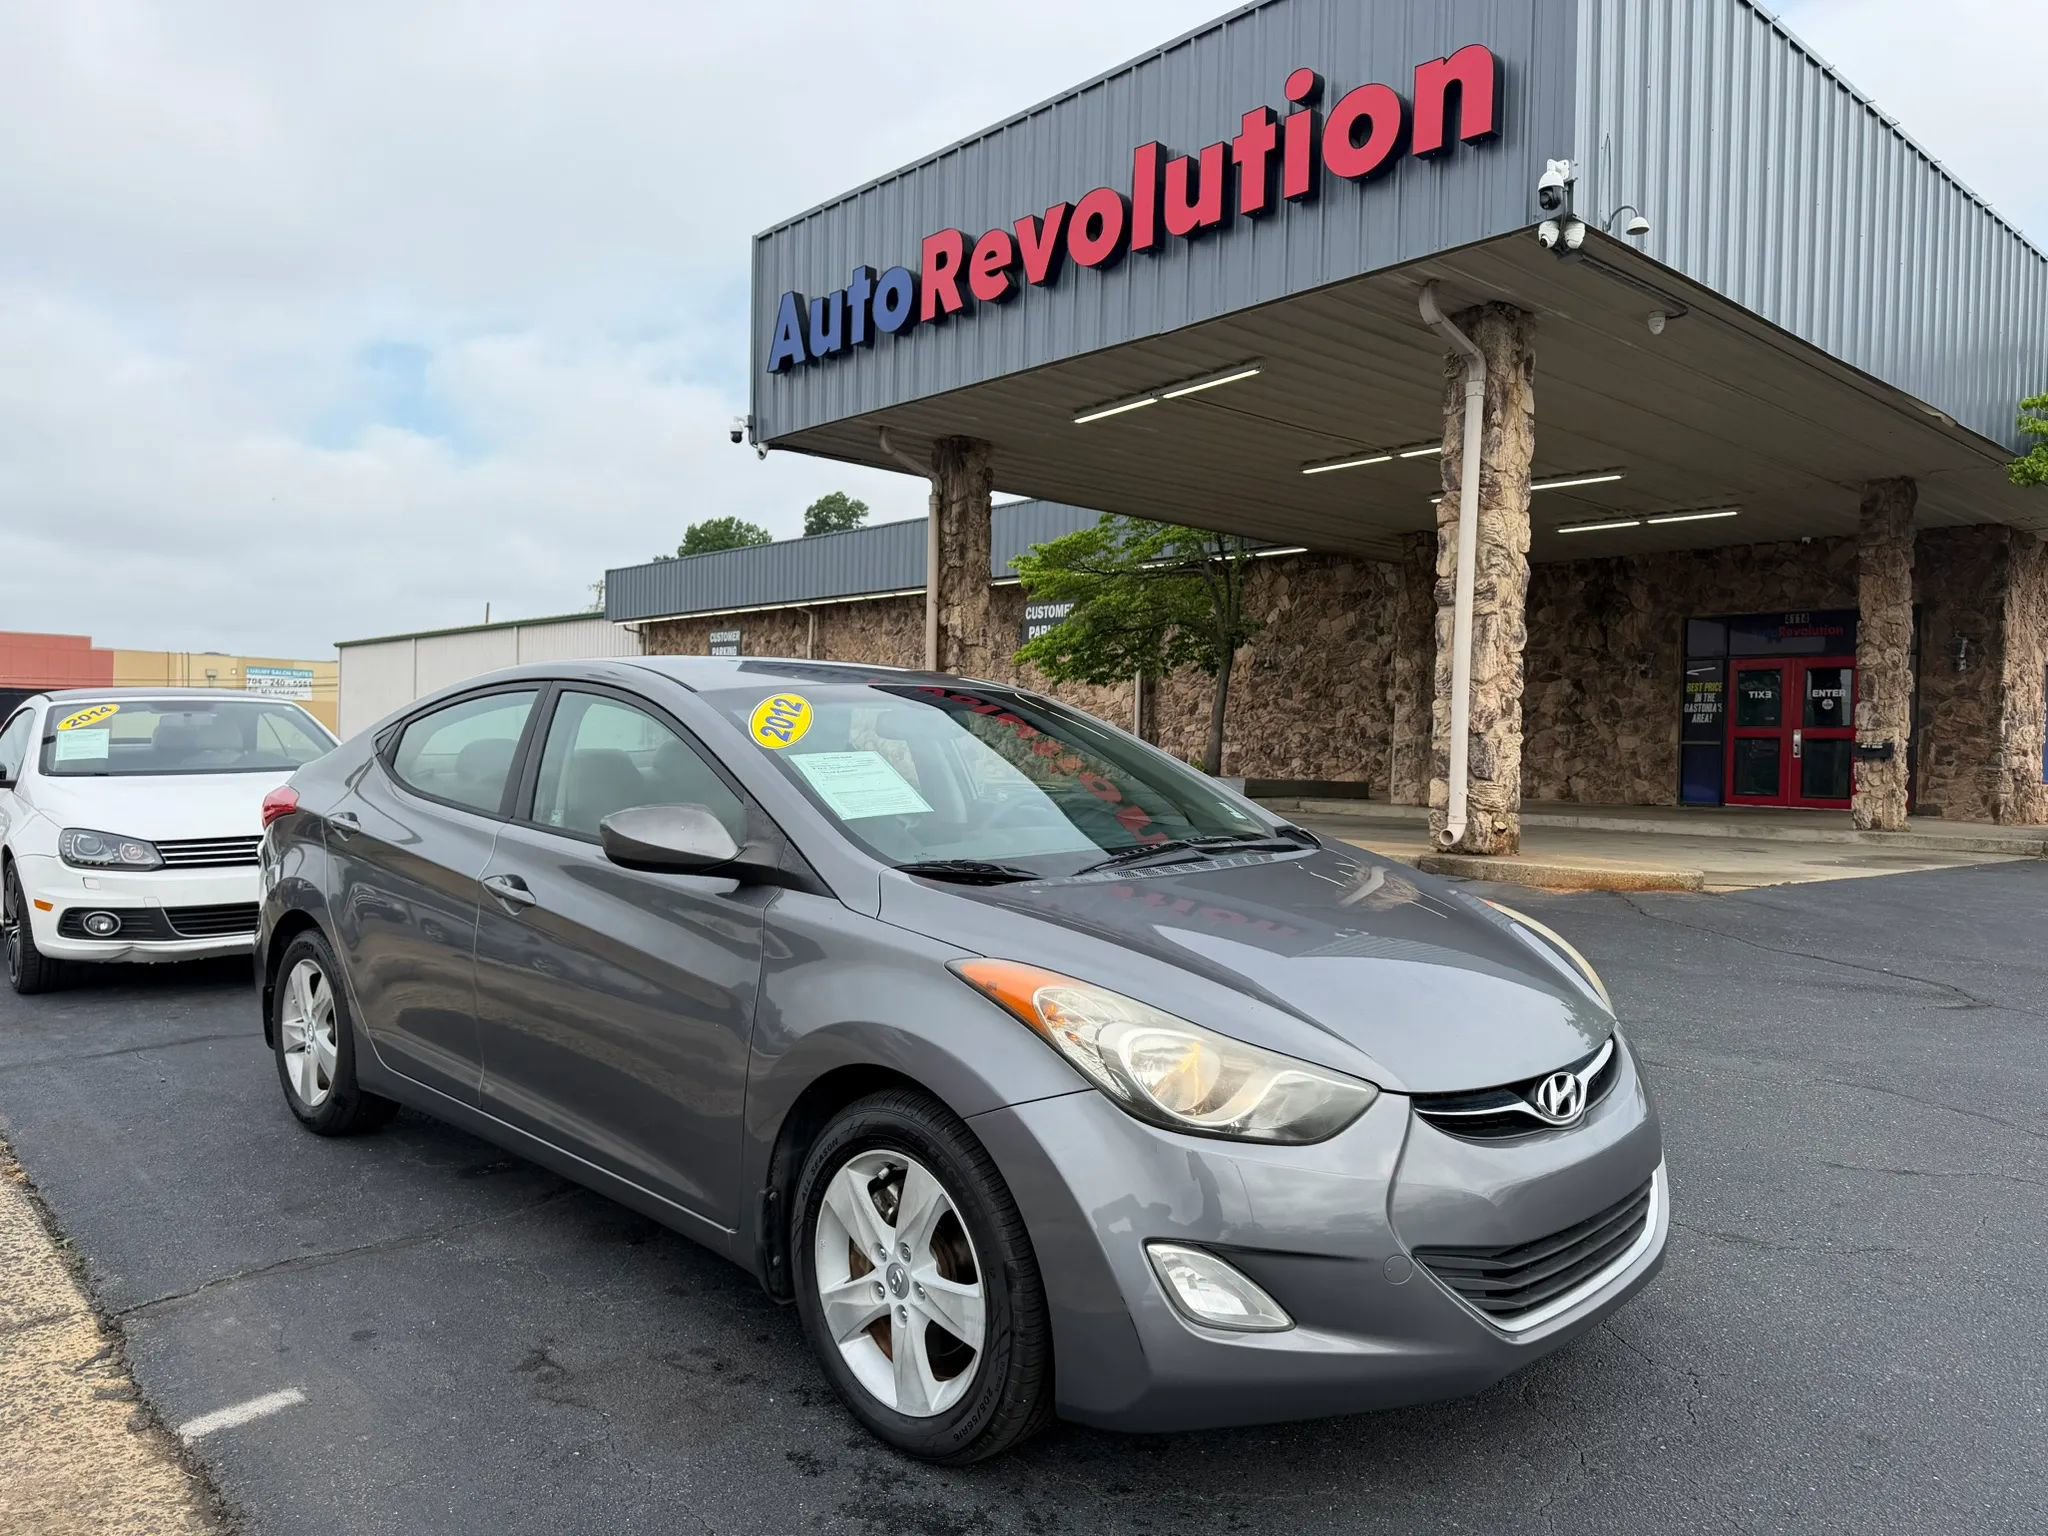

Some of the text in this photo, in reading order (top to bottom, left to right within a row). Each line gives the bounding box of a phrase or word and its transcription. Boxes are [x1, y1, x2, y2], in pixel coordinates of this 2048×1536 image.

[1025, 603, 1074, 620] CUSTOME
[710, 630, 740, 643] CUSTOMER
[711, 646, 737, 656] PARKING
[1686, 681, 1724, 693] BEST PRICE
[1812, 688, 1847, 698] ENTER
[1694, 692, 1716, 702] IN THE
[65, 706, 112, 727] 2014
[760, 698, 804, 743] 2012
[1691, 712, 1713, 724] AREA!
